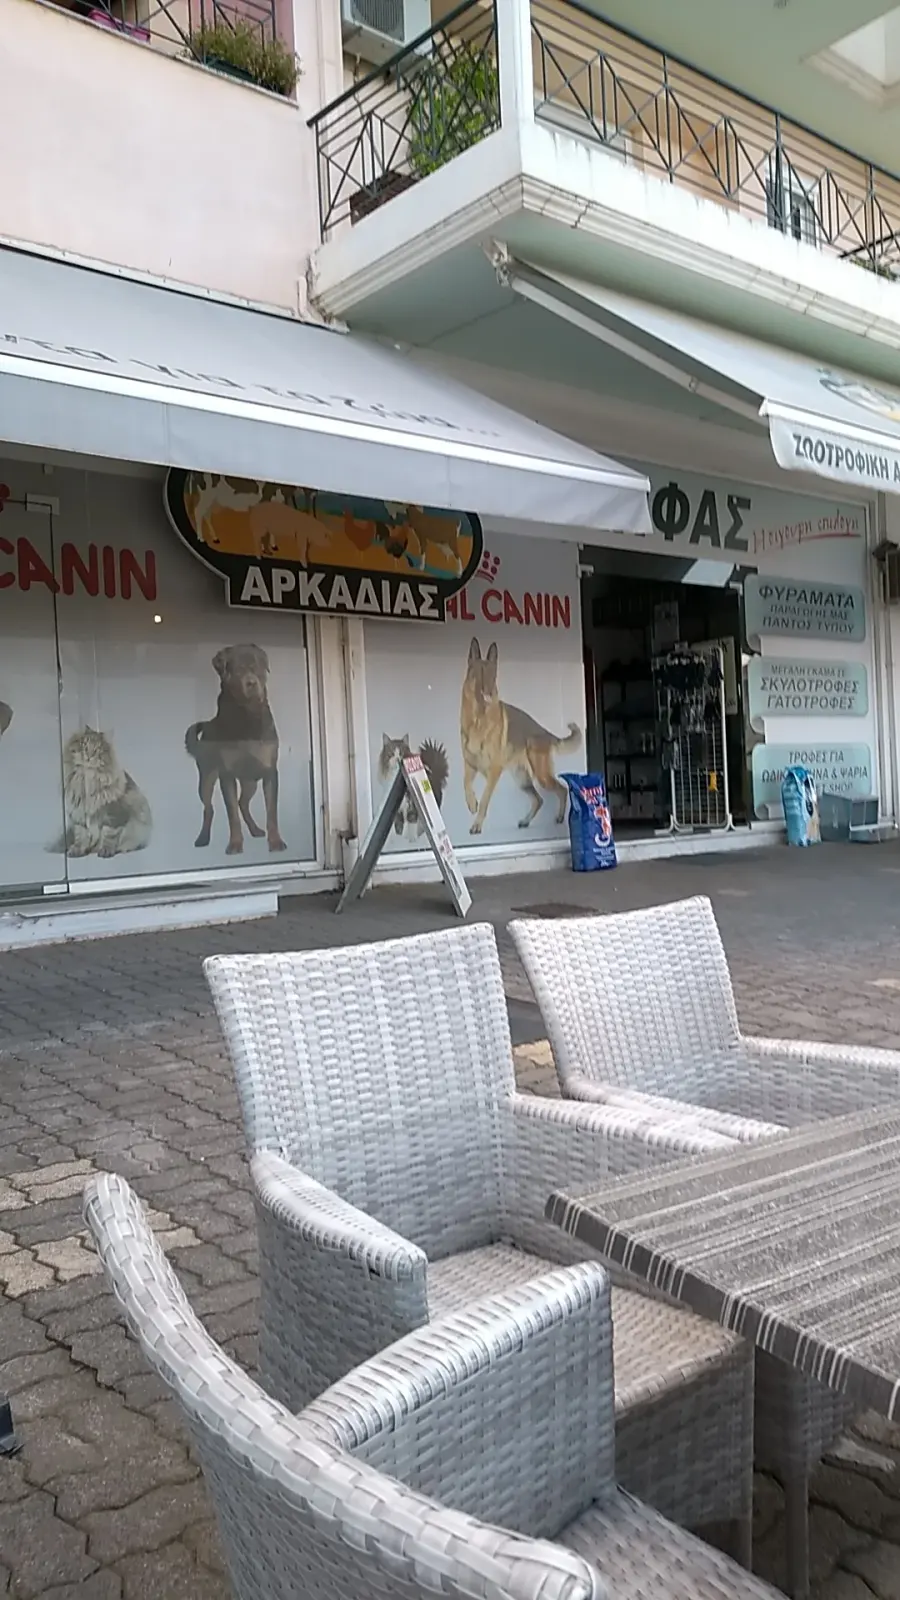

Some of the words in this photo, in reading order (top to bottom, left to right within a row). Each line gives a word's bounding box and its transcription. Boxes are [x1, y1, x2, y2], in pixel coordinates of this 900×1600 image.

[793, 433, 889, 480] ΖΩΟΤΡΟΦΙΚΗ
[650, 482, 751, 552] ΦΑΣ
[240, 566, 440, 618] ΑΡΚΑΔΙΑΣ
[759, 586, 854, 609] ΦΥΡΑΜΑΤΑ
[482, 588, 570, 628] CANIN
[763, 616, 811, 630] ΠΑΝΤΟΣ
[760, 677, 858, 693] ΣΚΥΛΟΤΡΟΦΕΣ
[767, 694, 855, 710] ΓΑΤΟΤΡΟΦΕΣ
[788, 751, 827, 763] ΤΡΟΦΕΣ
[762, 769, 788, 783] ΩΔΙΚ
[831, 767, 838, 779] &
[840, 766, 868, 779] ΨΑΡΙΑ
